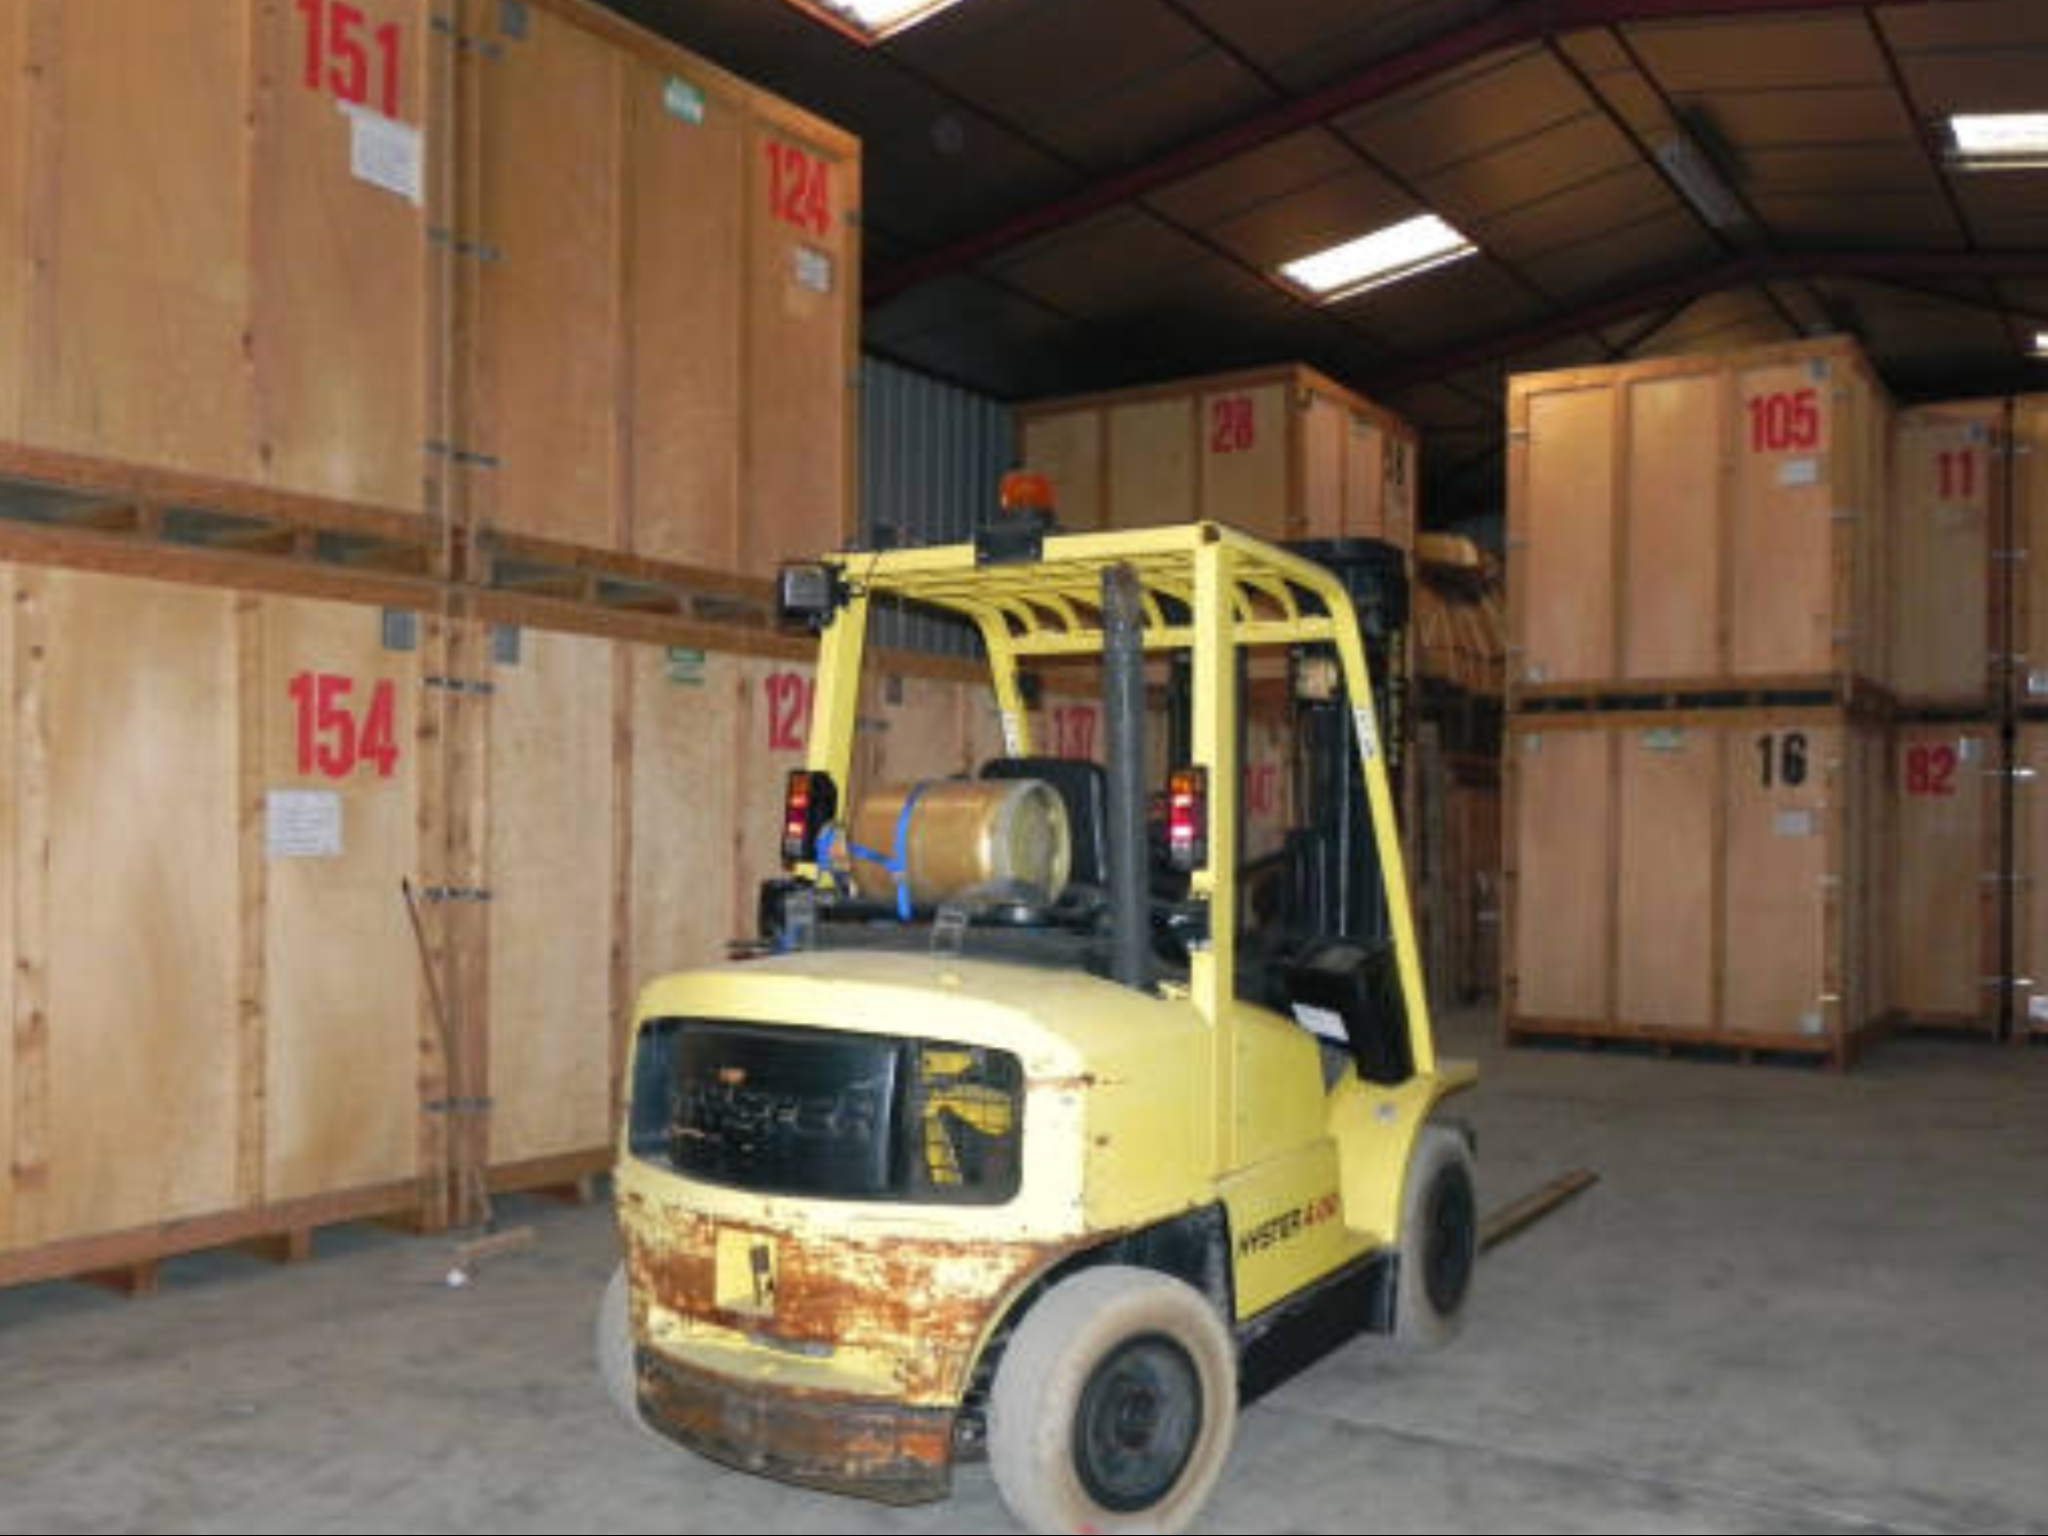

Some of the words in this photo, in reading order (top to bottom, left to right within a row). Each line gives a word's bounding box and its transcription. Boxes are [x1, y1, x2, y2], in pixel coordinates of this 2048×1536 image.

[295, 0, 400, 120] 151
[766, 141, 831, 236] 124
[1748, 389, 1817, 452] 105
[1936, 448, 1973, 499] 11
[288, 672, 397, 780] 154
[1756, 732, 1807, 788] 16
